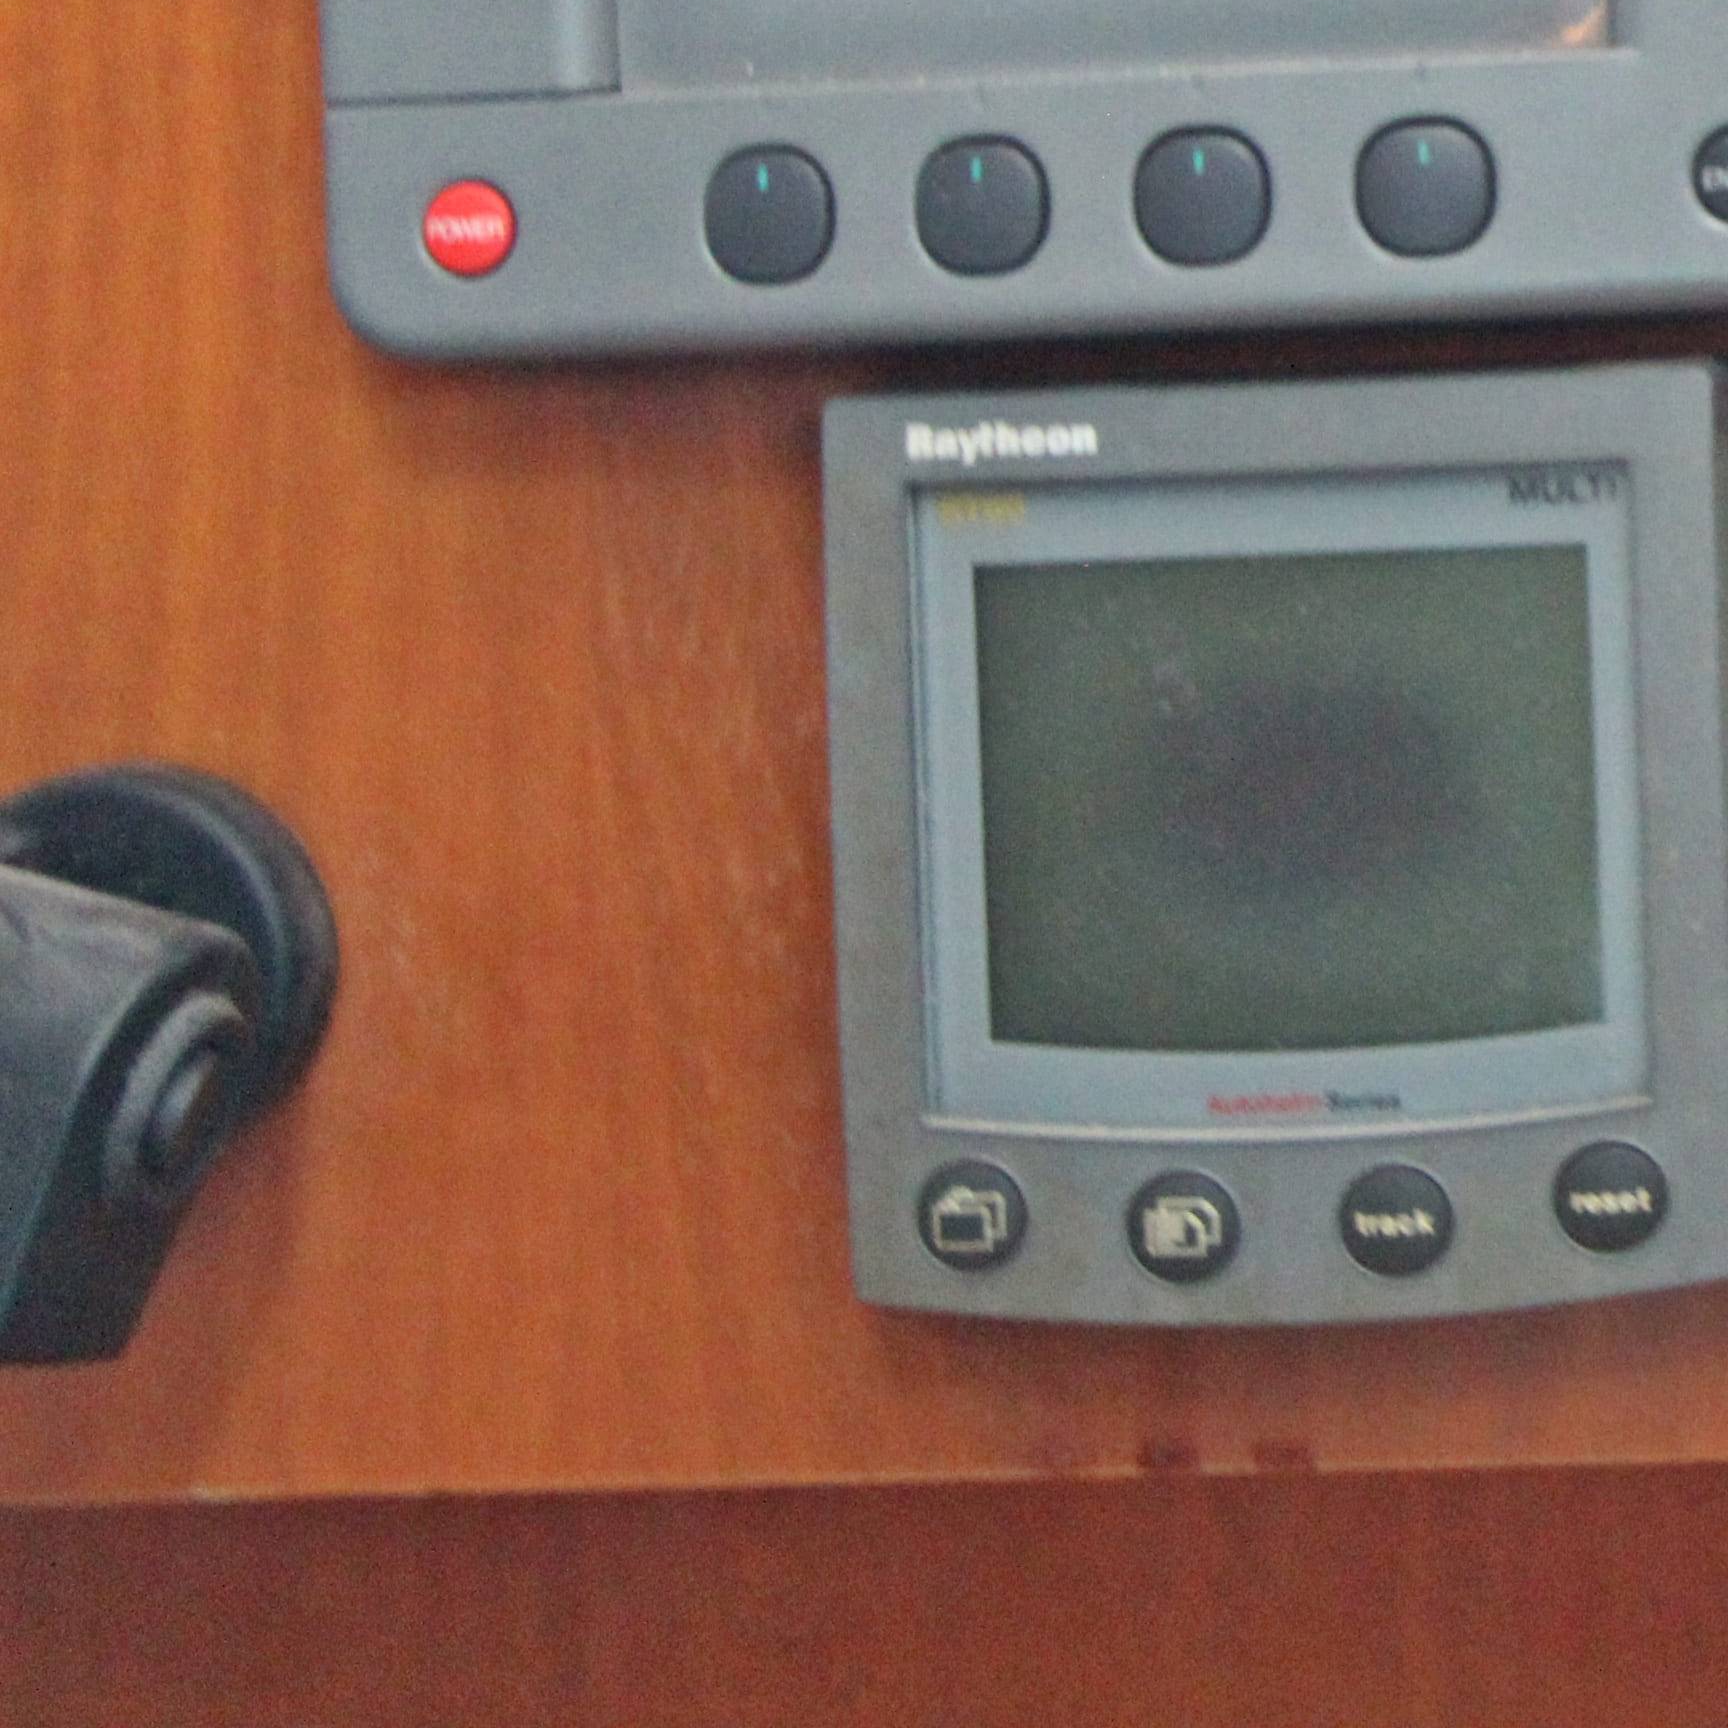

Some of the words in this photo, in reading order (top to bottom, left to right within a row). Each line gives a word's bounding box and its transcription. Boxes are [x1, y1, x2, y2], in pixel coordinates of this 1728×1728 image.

[428, 214, 506, 242] POWER
[905, 420, 1098, 465] Raytheon
[1569, 1184, 1655, 1218] reset
[1355, 1206, 1436, 1239] track
